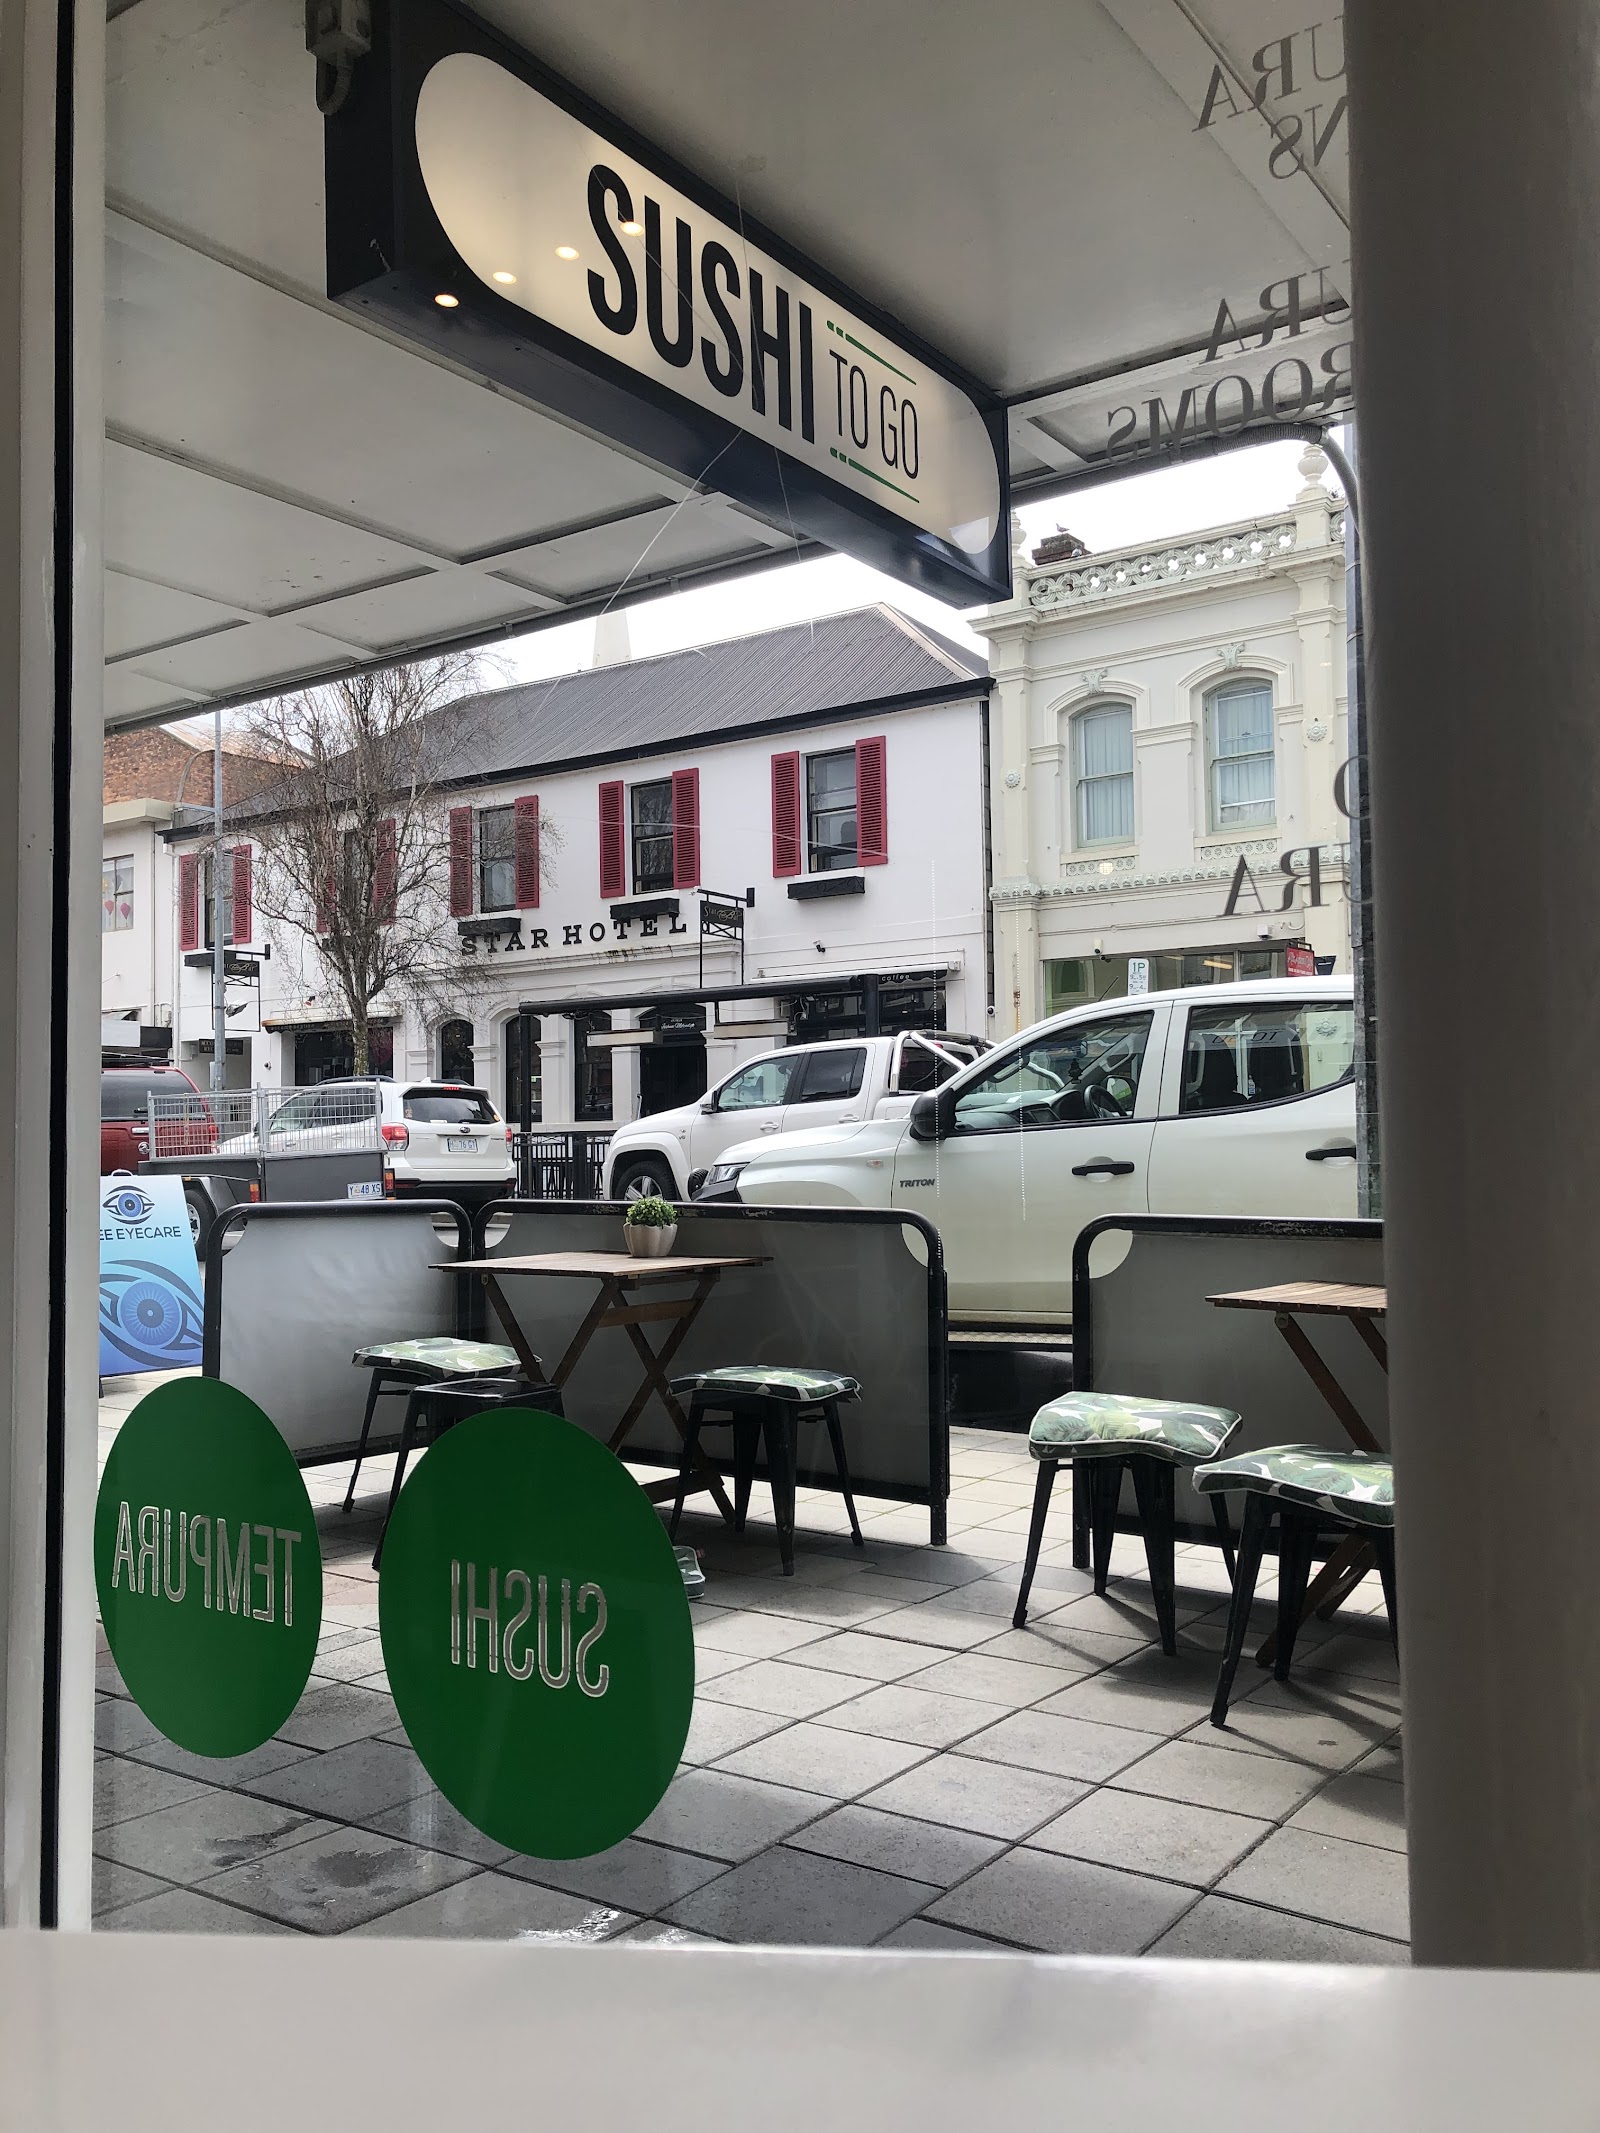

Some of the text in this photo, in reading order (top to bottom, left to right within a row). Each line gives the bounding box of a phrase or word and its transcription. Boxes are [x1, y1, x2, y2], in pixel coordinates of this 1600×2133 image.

[587, 164, 815, 444] SUSHI
[829, 349, 919, 479] TO GO
[462, 913, 687, 956] STAR HOTEL
[1133, 962, 1145, 972] 1P
[881, 974, 910, 982] coffee
[899, 1178, 936, 1188] TRITON
[116, 1226, 182, 1240] EYECARE
